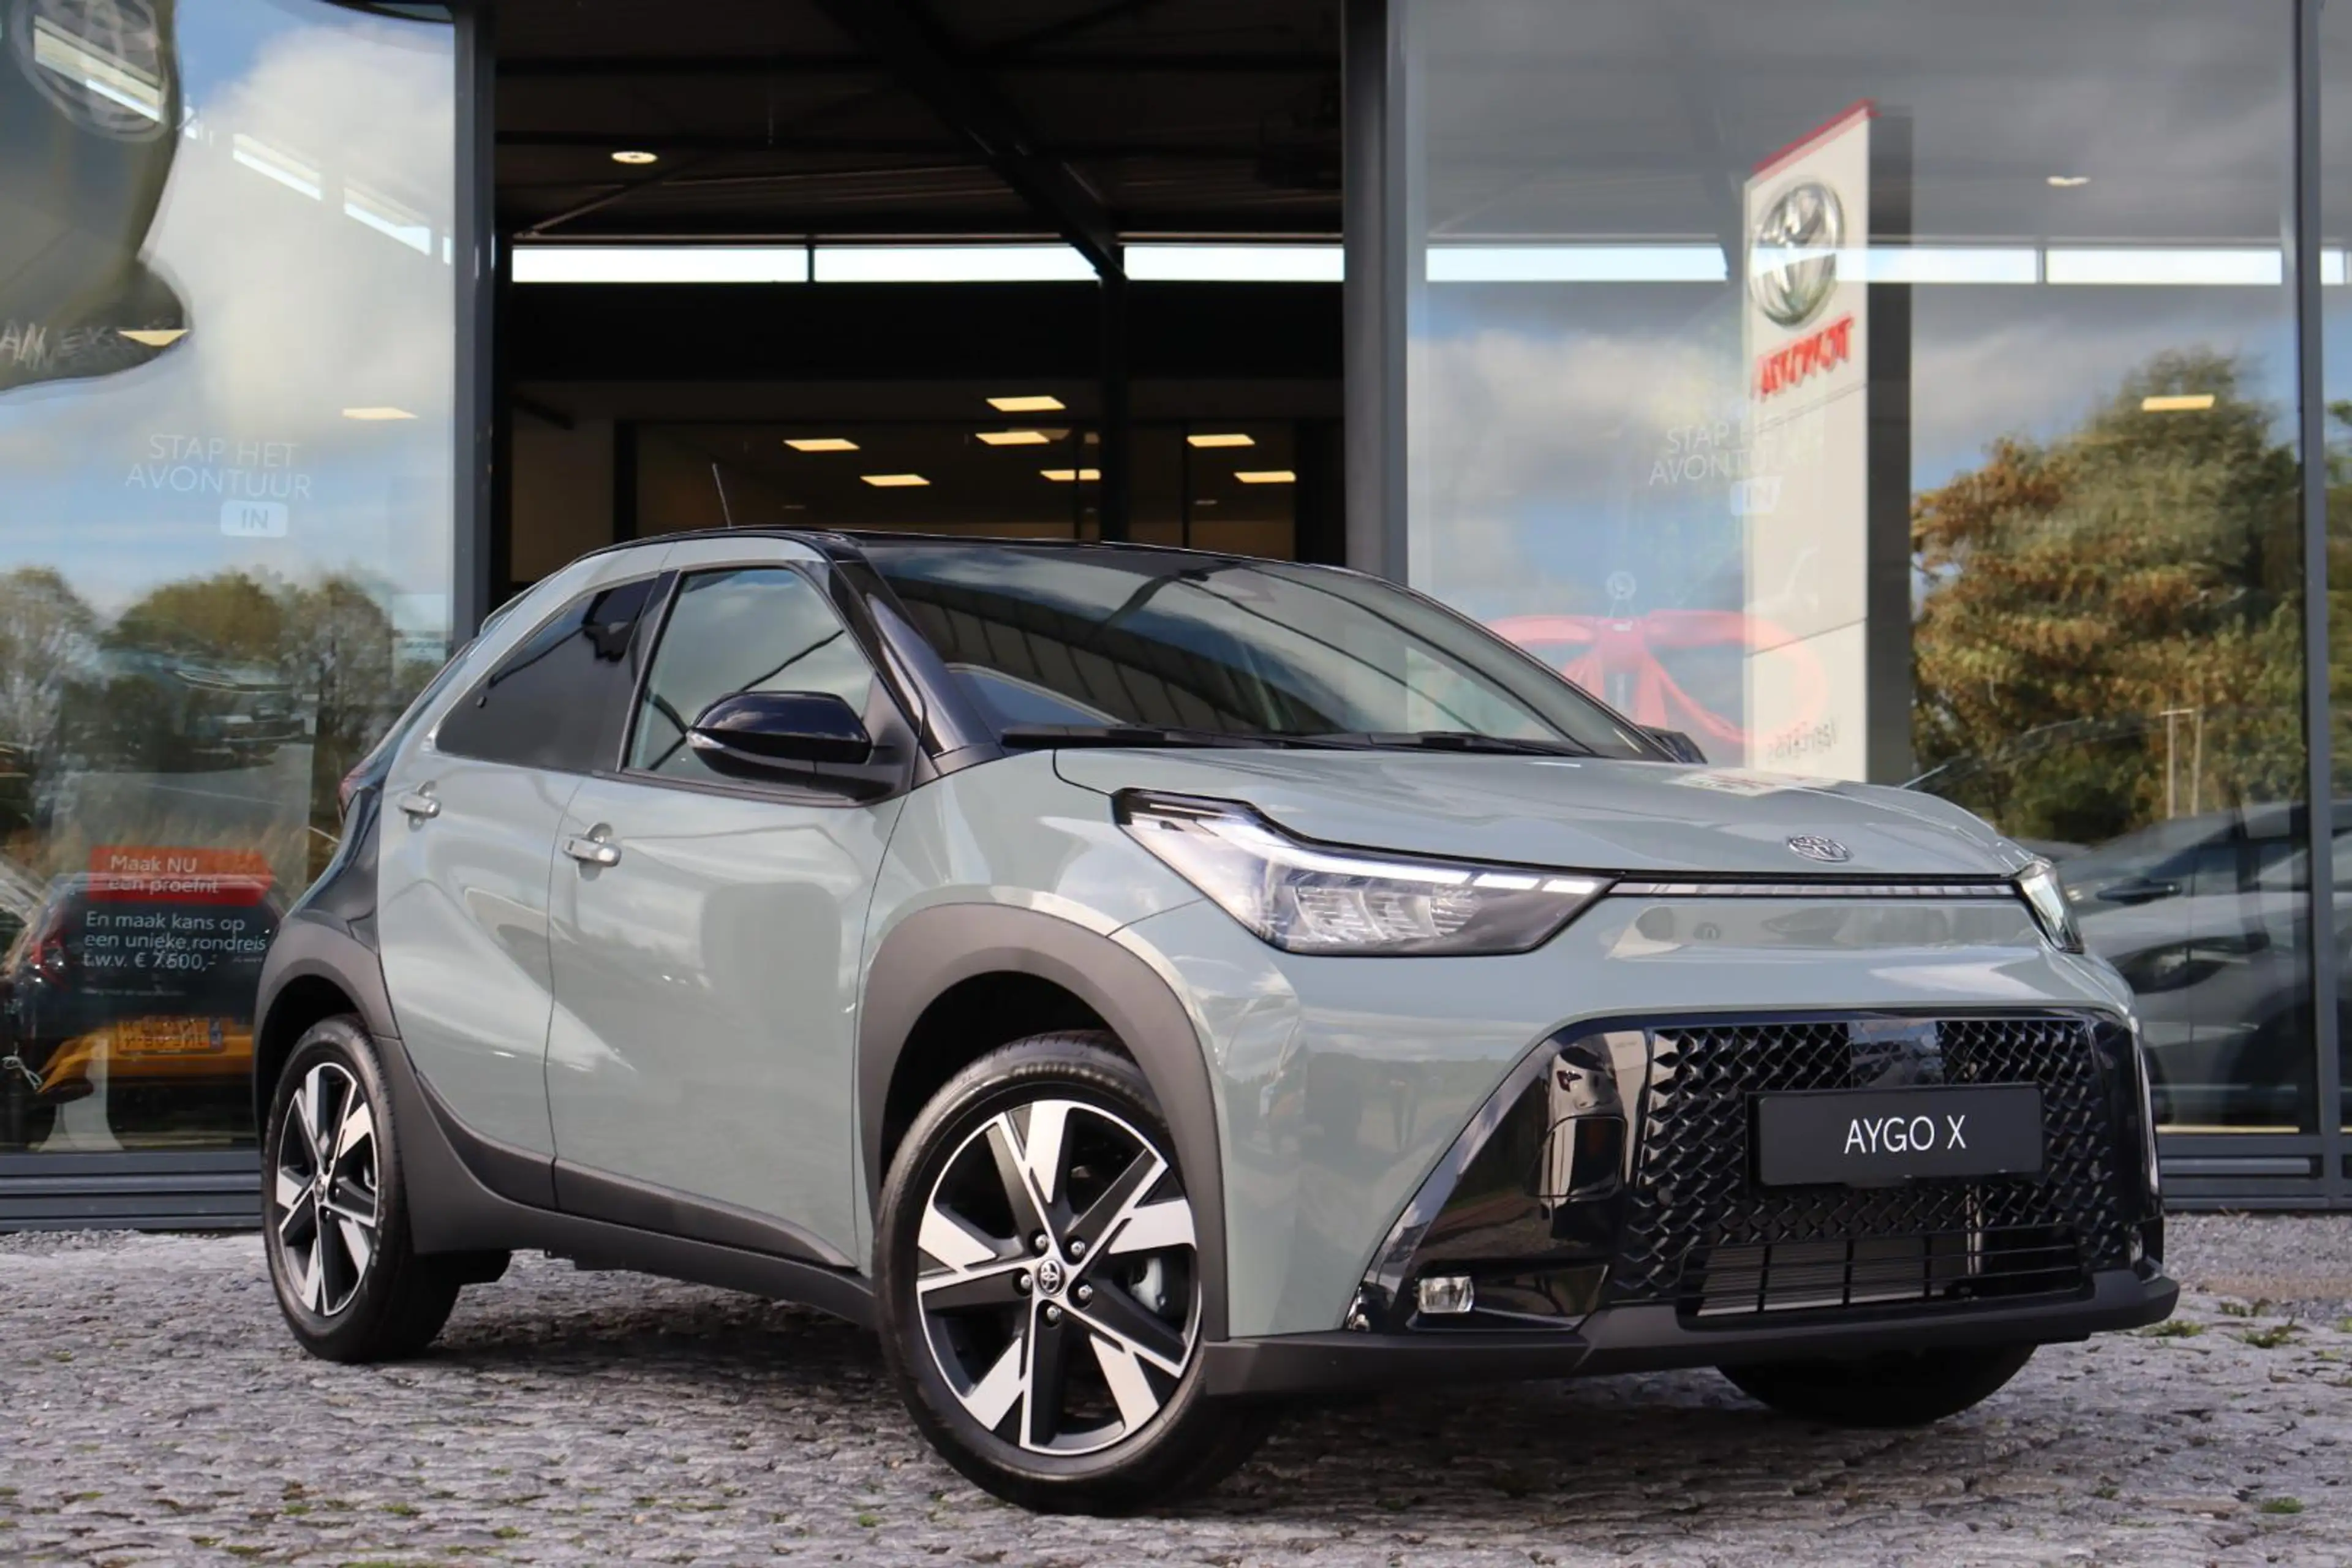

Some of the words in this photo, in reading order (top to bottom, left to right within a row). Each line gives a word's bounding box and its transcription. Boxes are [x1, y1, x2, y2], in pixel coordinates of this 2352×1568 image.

[149, 433, 225, 464] STAP
[237, 442, 299, 467] HET
[1667, 421, 1729, 454] STAP
[125, 463, 311, 499] AVONTUUR
[241, 508, 268, 530] IN
[111, 855, 161, 871] Maak
[167, 858, 197, 873] NU
[86, 912, 109, 927] En
[116, 913, 166, 929] maak
[172, 913, 214, 930] kans
[221, 919, 245, 937] op
[84, 935, 119, 947] een
[125, 932, 186, 949] unieke
[192, 934, 266, 951] rondreis
[83, 952, 127, 967] t.w.v.
[135, 952, 147, 968] €
[1844, 1115, 1935, 1154] AYGO
[1947, 1115, 1966, 1150] X
